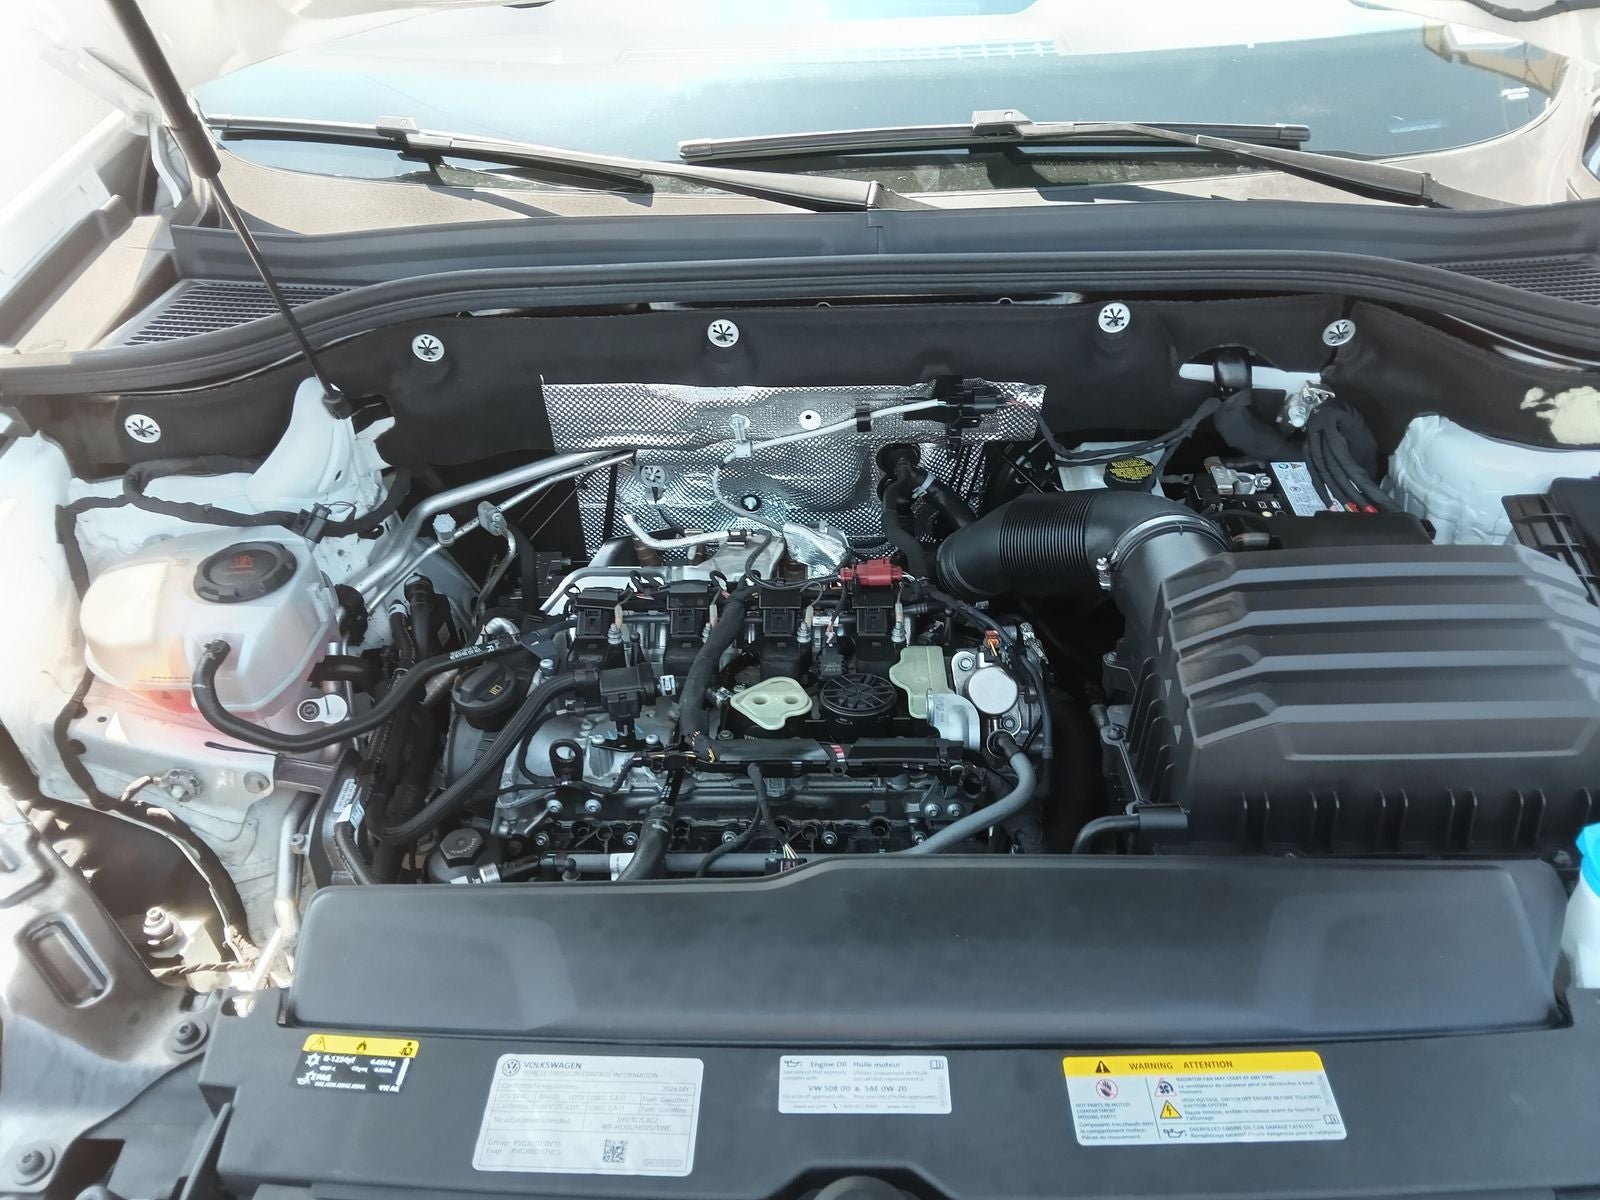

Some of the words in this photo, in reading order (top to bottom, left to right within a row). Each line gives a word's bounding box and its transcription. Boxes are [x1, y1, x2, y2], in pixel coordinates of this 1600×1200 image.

[524, 1061, 582, 1069] VOLKSWAGEN
[811, 1061, 835, 1069] Engine
[1128, 1062, 1173, 1070] WARNING
[1183, 1060, 1233, 1069] ATTENTION
